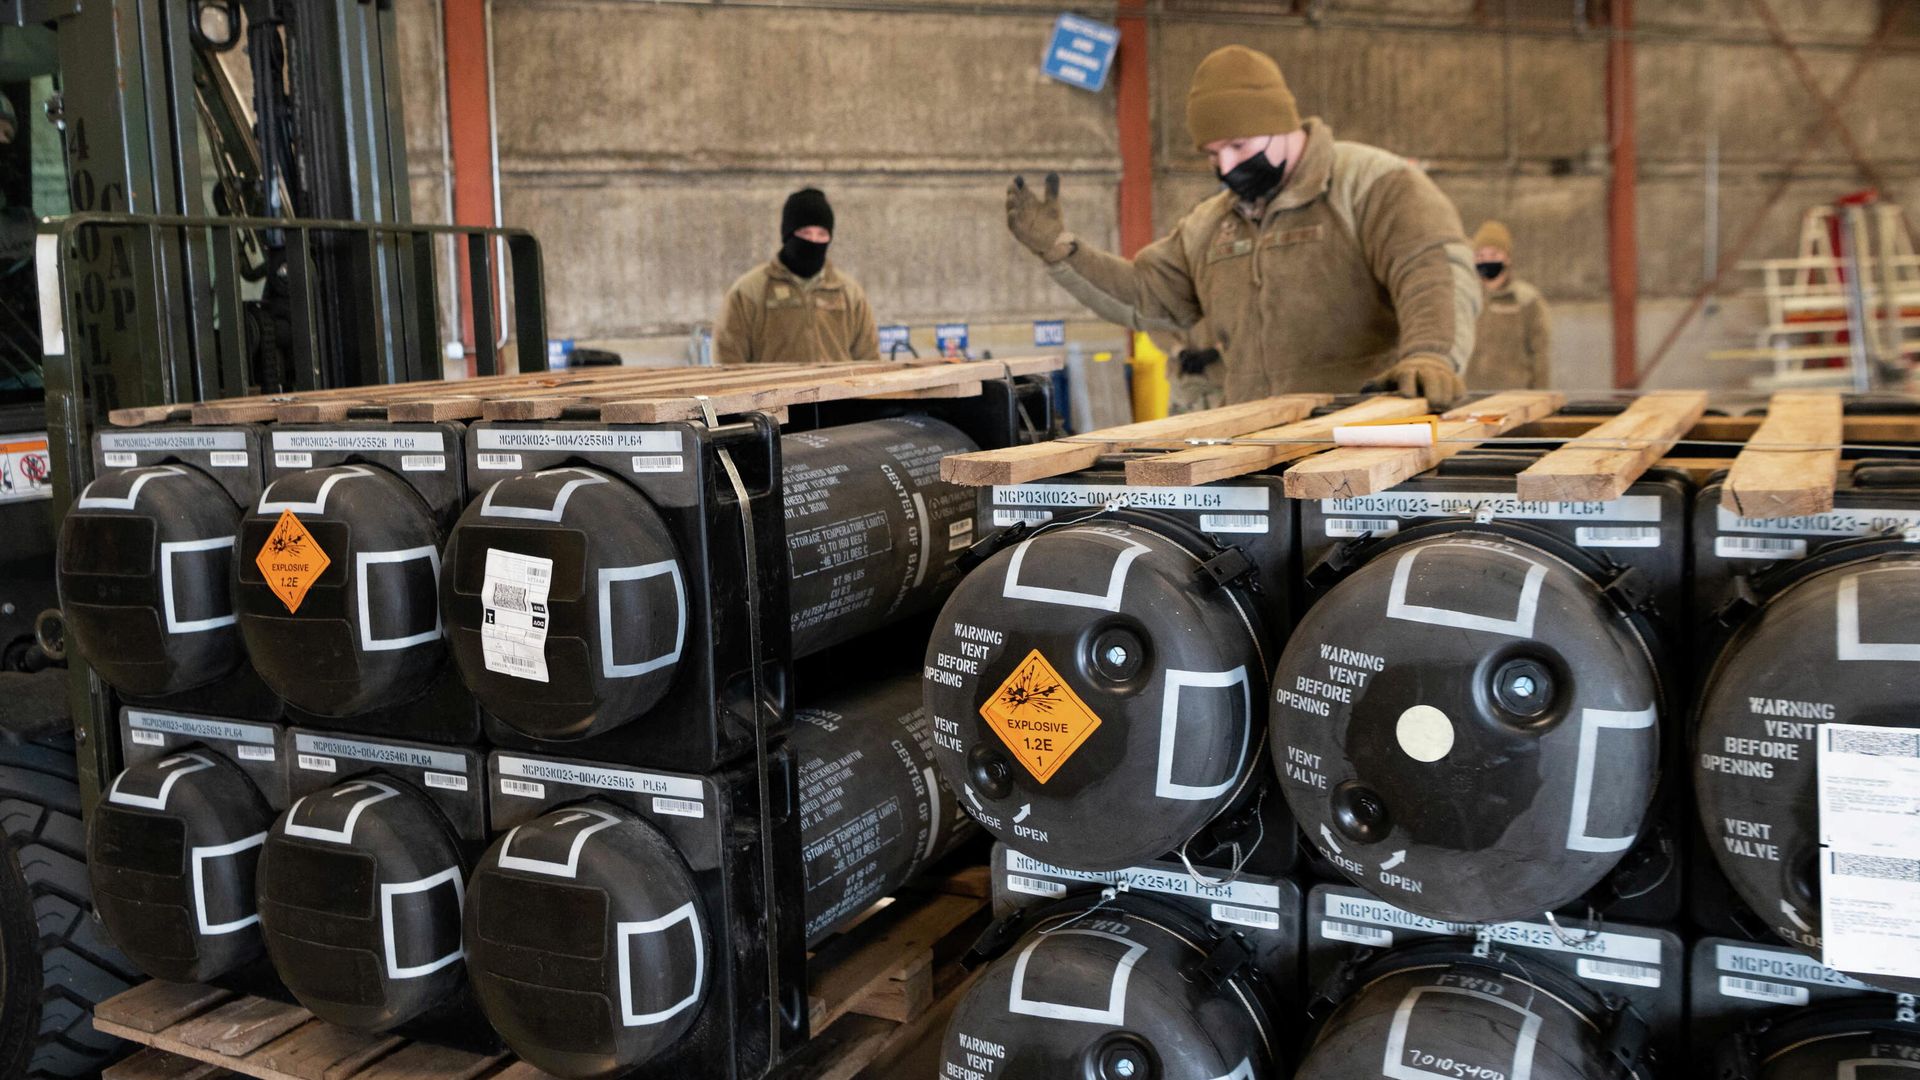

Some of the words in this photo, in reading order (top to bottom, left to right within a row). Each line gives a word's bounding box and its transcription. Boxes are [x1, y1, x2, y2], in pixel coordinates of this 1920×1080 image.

[393, 438, 415, 449] PL64
[499, 434, 614, 446] MGP03K023-004/325589
[617, 435, 642, 447] PL64
[880, 463, 915, 520] CENTER
[1183, 493, 1221, 507] PL64
[1558, 499, 1605, 515] PL64
[790, 532, 822, 549] STORAGE
[822, 523, 866, 541] TEMPERATURE
[828, 542, 838, 553] TO
[850, 534, 863, 547] DEG
[908, 526, 918, 547] OF
[272, 563, 309, 572] EXPLOSIVE
[832, 553, 842, 565] TO
[281, 577, 299, 588] 1.2E
[954, 622, 1003, 645] WARNING
[960, 641, 989, 660] VENT
[1320, 643, 1385, 672] WARNING
[937, 653, 978, 675] BEFORE
[925, 666, 963, 688] OPENING
[1329, 665, 1367, 688] VENT
[1296, 675, 1352, 704] BEFORE
[1276, 688, 1330, 717] OPENING
[1749, 696, 1836, 721] WARNING
[223, 727, 243, 738] PL64
[934, 715, 959, 735] VENT
[1007, 719, 1068, 734] EXPLOSIVE
[1764, 719, 1816, 741] VENT
[934, 731, 963, 753] VALVE
[1023, 737, 1053, 752] 1.2E
[1724, 736, 1800, 761] BEFORE
[410, 753, 433, 766] PL64
[891, 739, 925, 797] CENTER
[1036, 755, 1043, 767] 1
[1288, 745, 1322, 770] VENT
[1701, 753, 1775, 779] OPENING
[522, 763, 635, 789] MGP03K023-004/325613
[642, 779, 668, 792] PL64
[1285, 762, 1327, 790] VALVE
[819, 785, 845, 805] MARTIN
[965, 804, 1002, 830] CLOSE
[805, 836, 837, 863] STORAGE
[835, 811, 880, 844] TEMPERATURE
[1013, 824, 1049, 843] OPEN
[1724, 817, 1772, 840] VENT
[1723, 836, 1780, 862] VALVE
[1318, 845, 1364, 877] CLOSE
[1379, 871, 1423, 894] OPEN
[1066, 918, 1126, 935] FWD
[1779, 926, 1823, 949] CLOS
[1435, 973, 1505, 995] FWD
[959, 1032, 1005, 1059] WARNING
[966, 1052, 994, 1073] VENT
